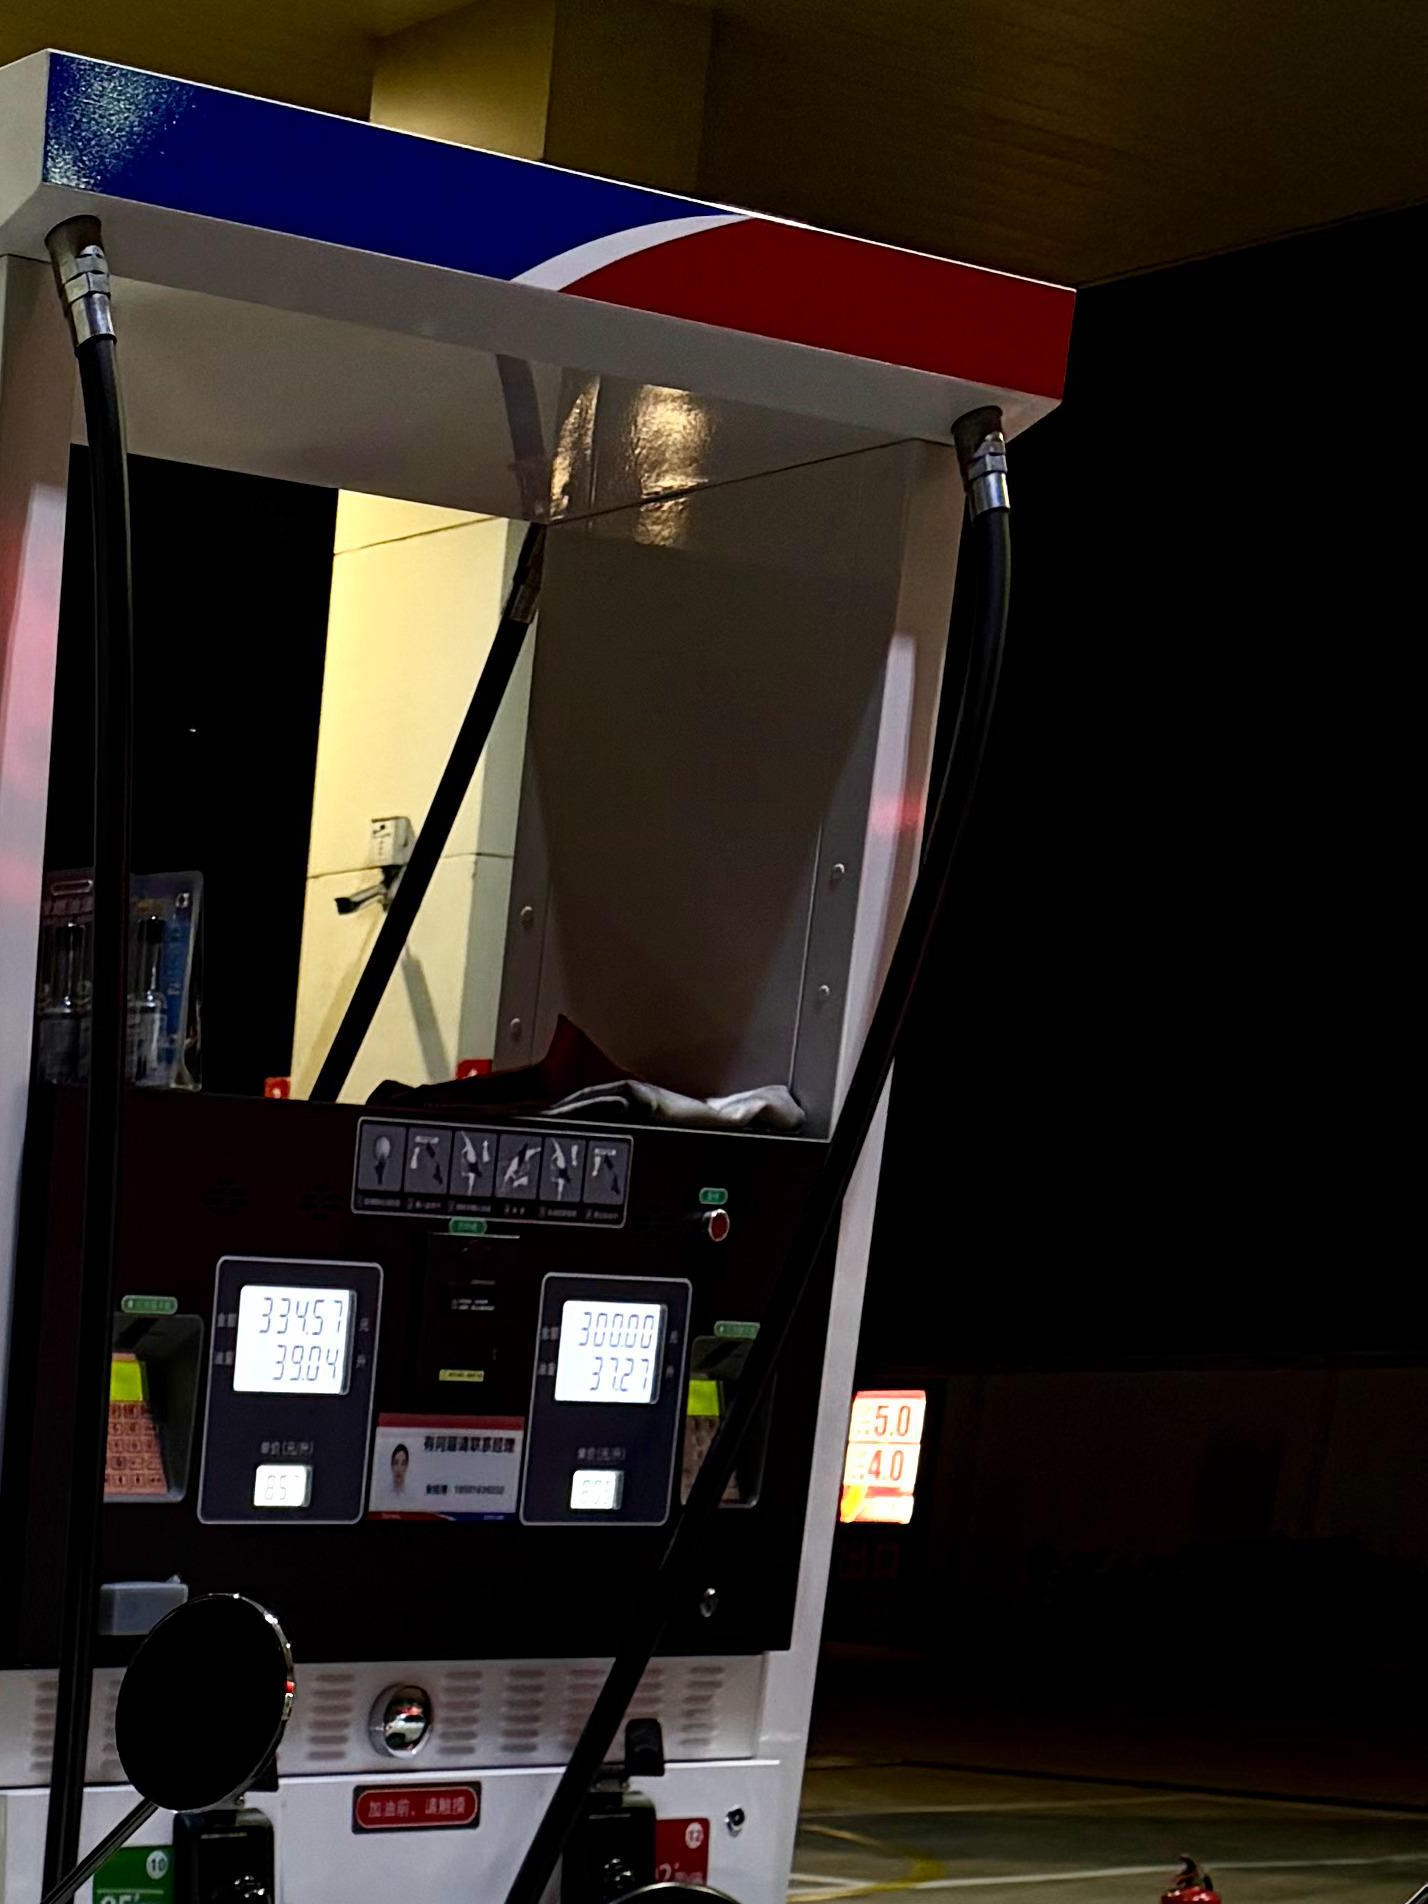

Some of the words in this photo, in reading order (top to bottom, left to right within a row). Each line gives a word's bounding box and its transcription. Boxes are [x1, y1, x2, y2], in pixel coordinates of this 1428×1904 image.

[259, 1297, 343, 1336] 334.57
[579, 1312, 655, 1349] 300.00
[272, 1345, 339, 1381] 39.04
[589, 1357, 649, 1392] 37.27
[874, 1405, 911, 1438] 5.0
[868, 1450, 905, 1482] 4.0
